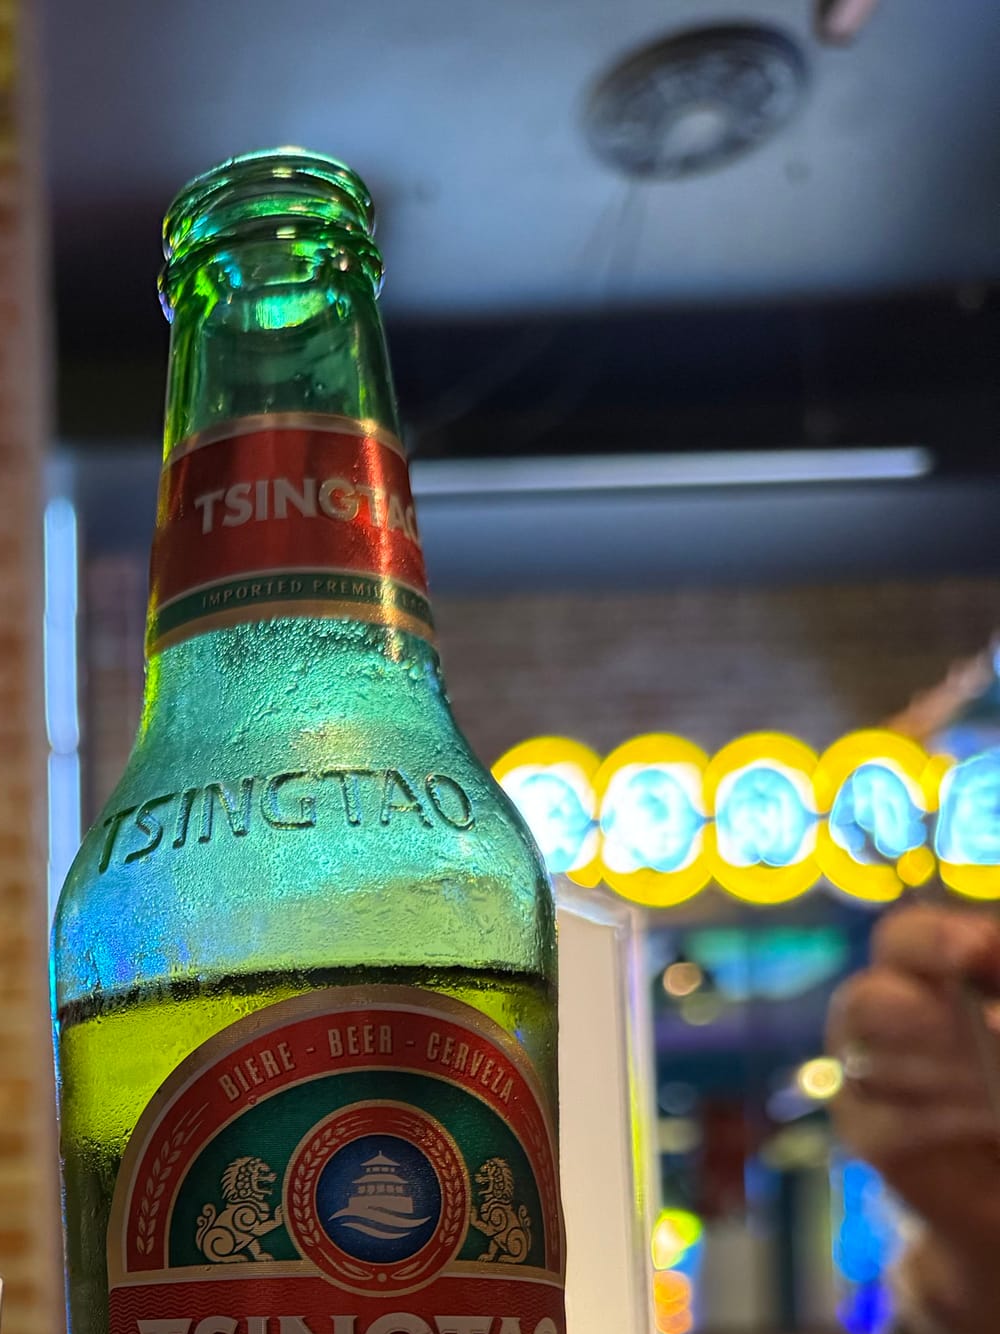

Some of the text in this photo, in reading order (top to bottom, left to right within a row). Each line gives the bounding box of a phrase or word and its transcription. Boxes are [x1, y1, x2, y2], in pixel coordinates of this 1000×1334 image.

[202, 579, 302, 609] IMPORTED
[99, 767, 476, 874] TSINGTAO
[218, 1024, 513, 1104] BIERE BEER CERVEZA
